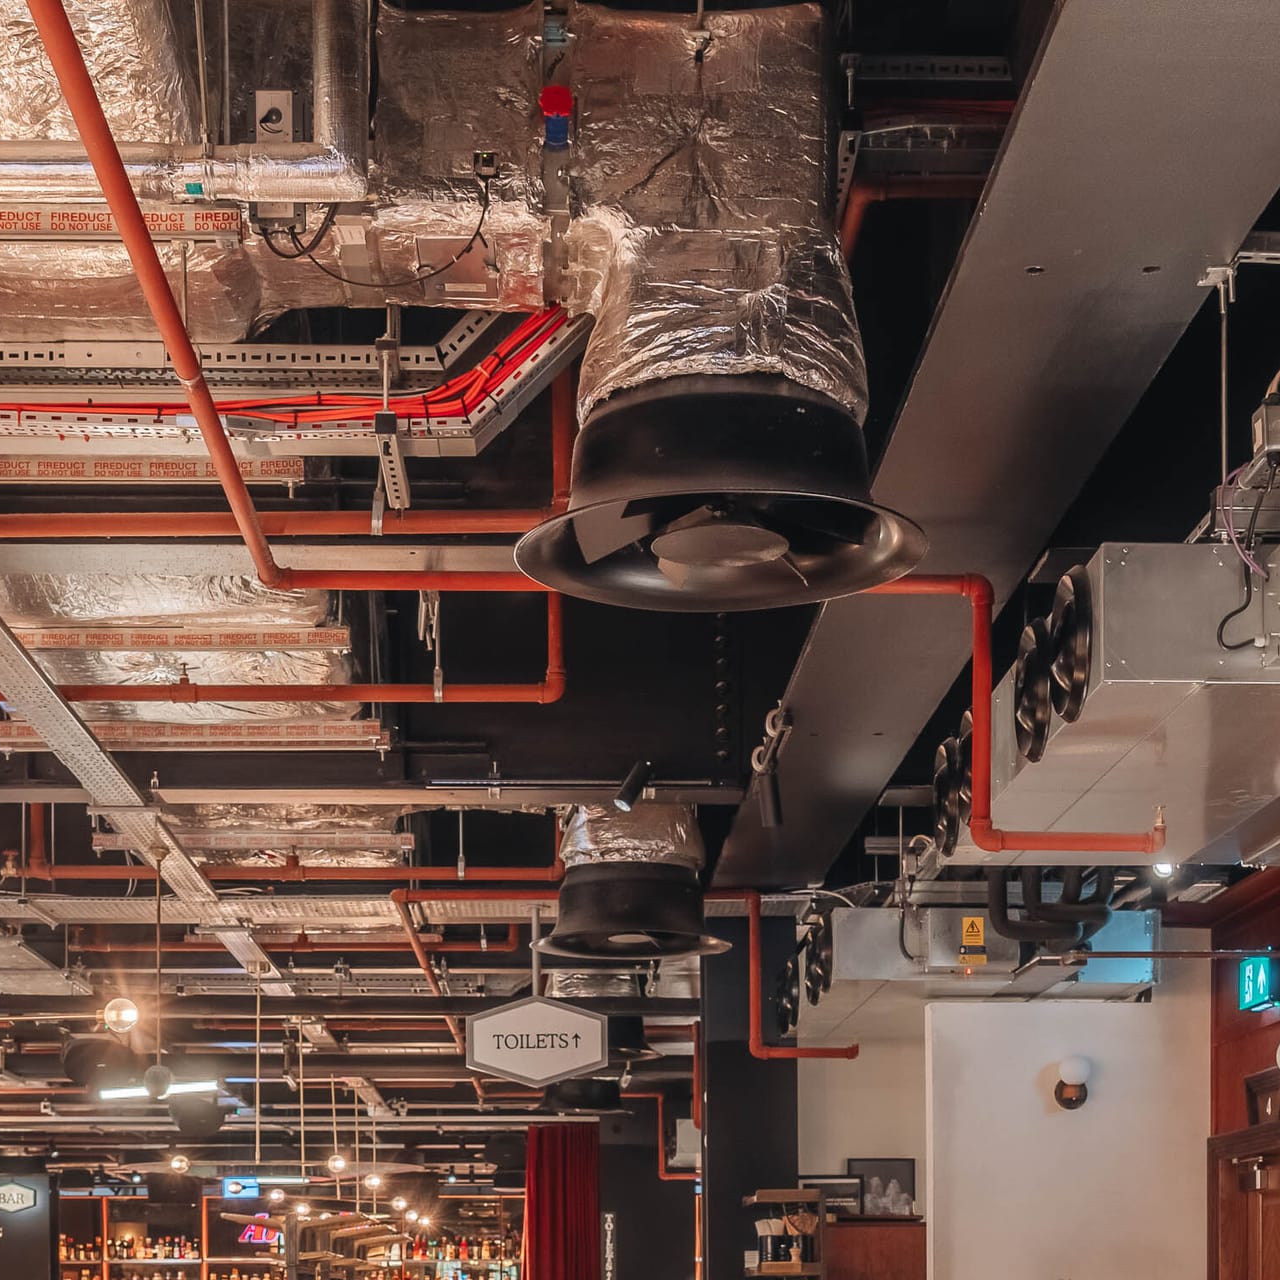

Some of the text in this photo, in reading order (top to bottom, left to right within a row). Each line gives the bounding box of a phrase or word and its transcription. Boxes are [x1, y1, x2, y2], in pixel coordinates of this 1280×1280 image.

[50, 212, 113, 222] FIREDUCT
[145, 212, 184, 222] EDUCT
[194, 212, 240, 222] FIREDU
[21, 222, 41, 231] USE
[51, 222, 113, 231] DO NOT USE
[149, 222, 185, 231] OT USE
[195, 222, 232, 231] DO NOT
[37, 461, 86, 469] FIREDUCT
[260, 460, 302, 468] FIREDUC
[493, 1033, 569, 1050] TOILETS
